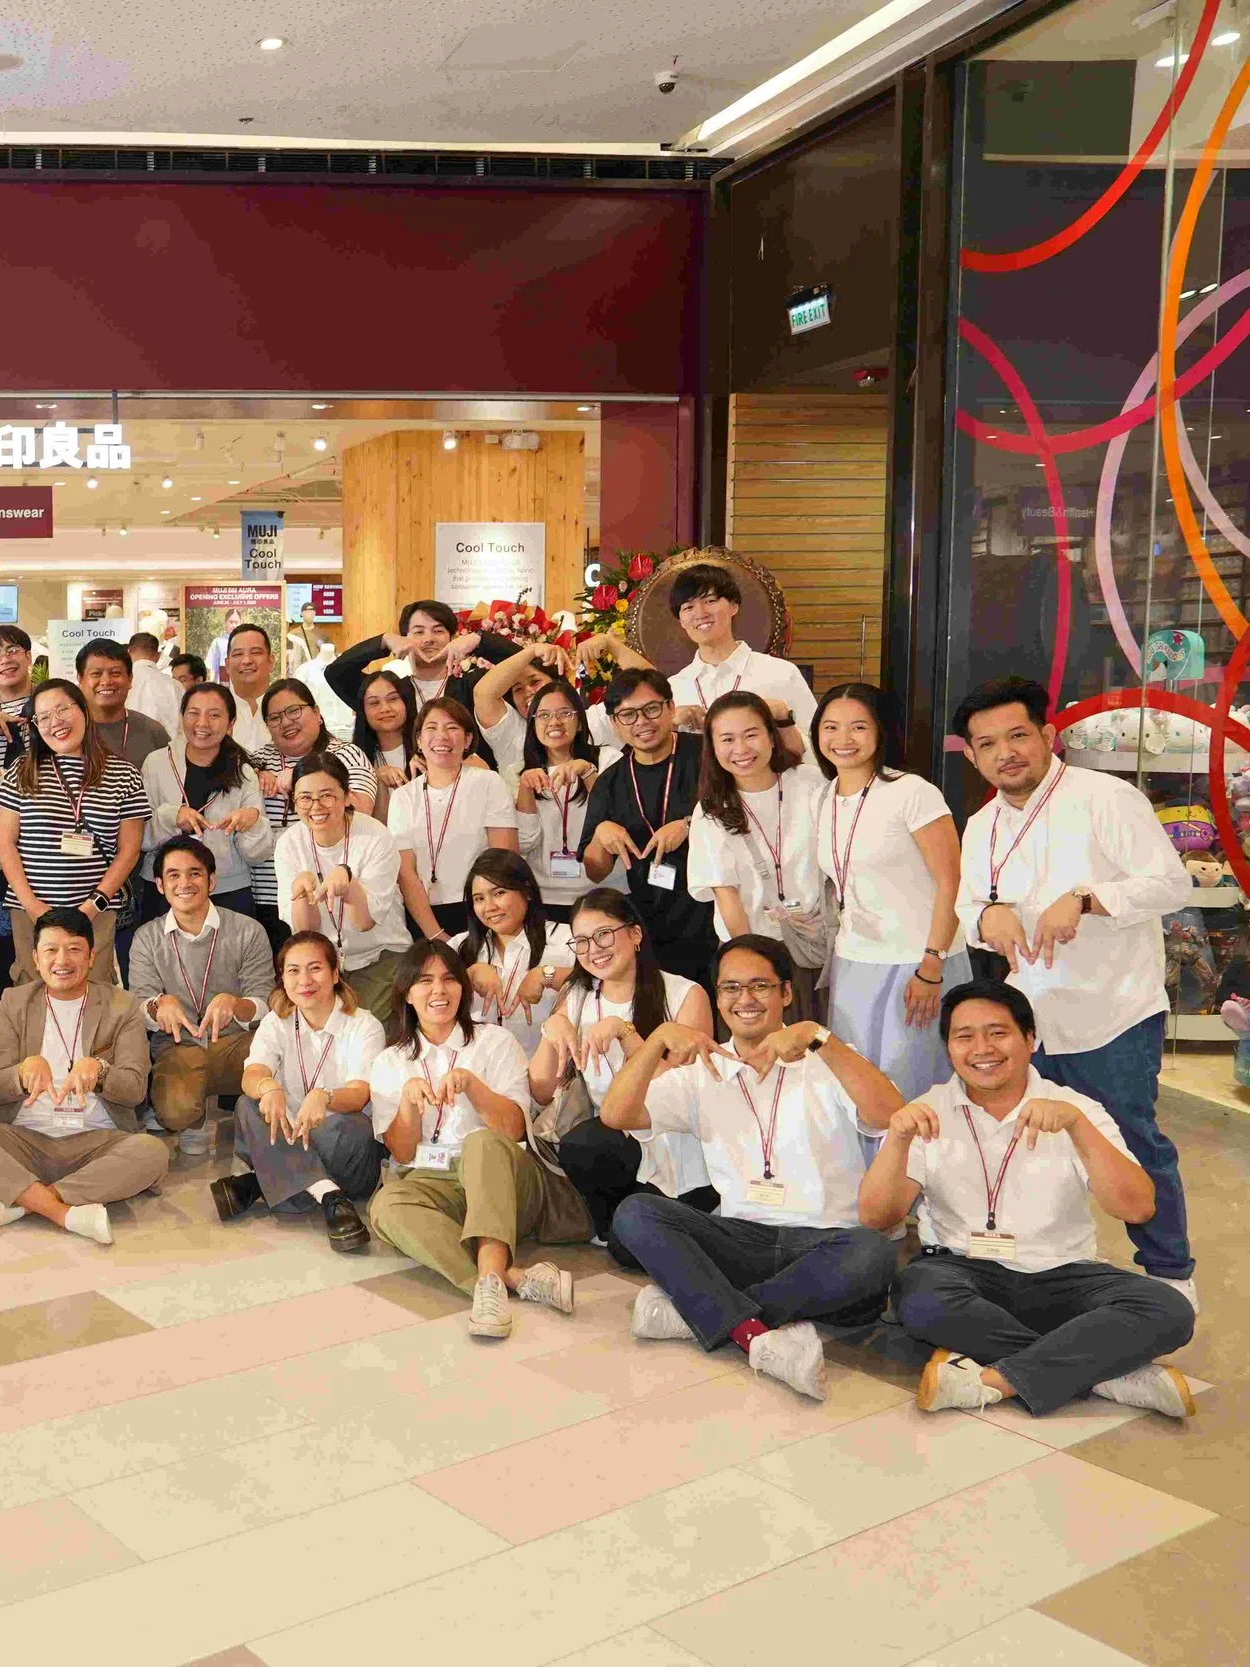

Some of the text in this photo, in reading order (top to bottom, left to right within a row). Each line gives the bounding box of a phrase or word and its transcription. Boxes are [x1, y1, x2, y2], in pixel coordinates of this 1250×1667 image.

[791, 303, 826, 328] FIRE EXIT
[247, 525, 278, 538] MUJI
[456, 542, 525, 553] Cool Touch
[249, 548, 277, 559] Cool
[245, 559, 282, 569] Touch
[62, 629, 116, 638] Cool Touch
